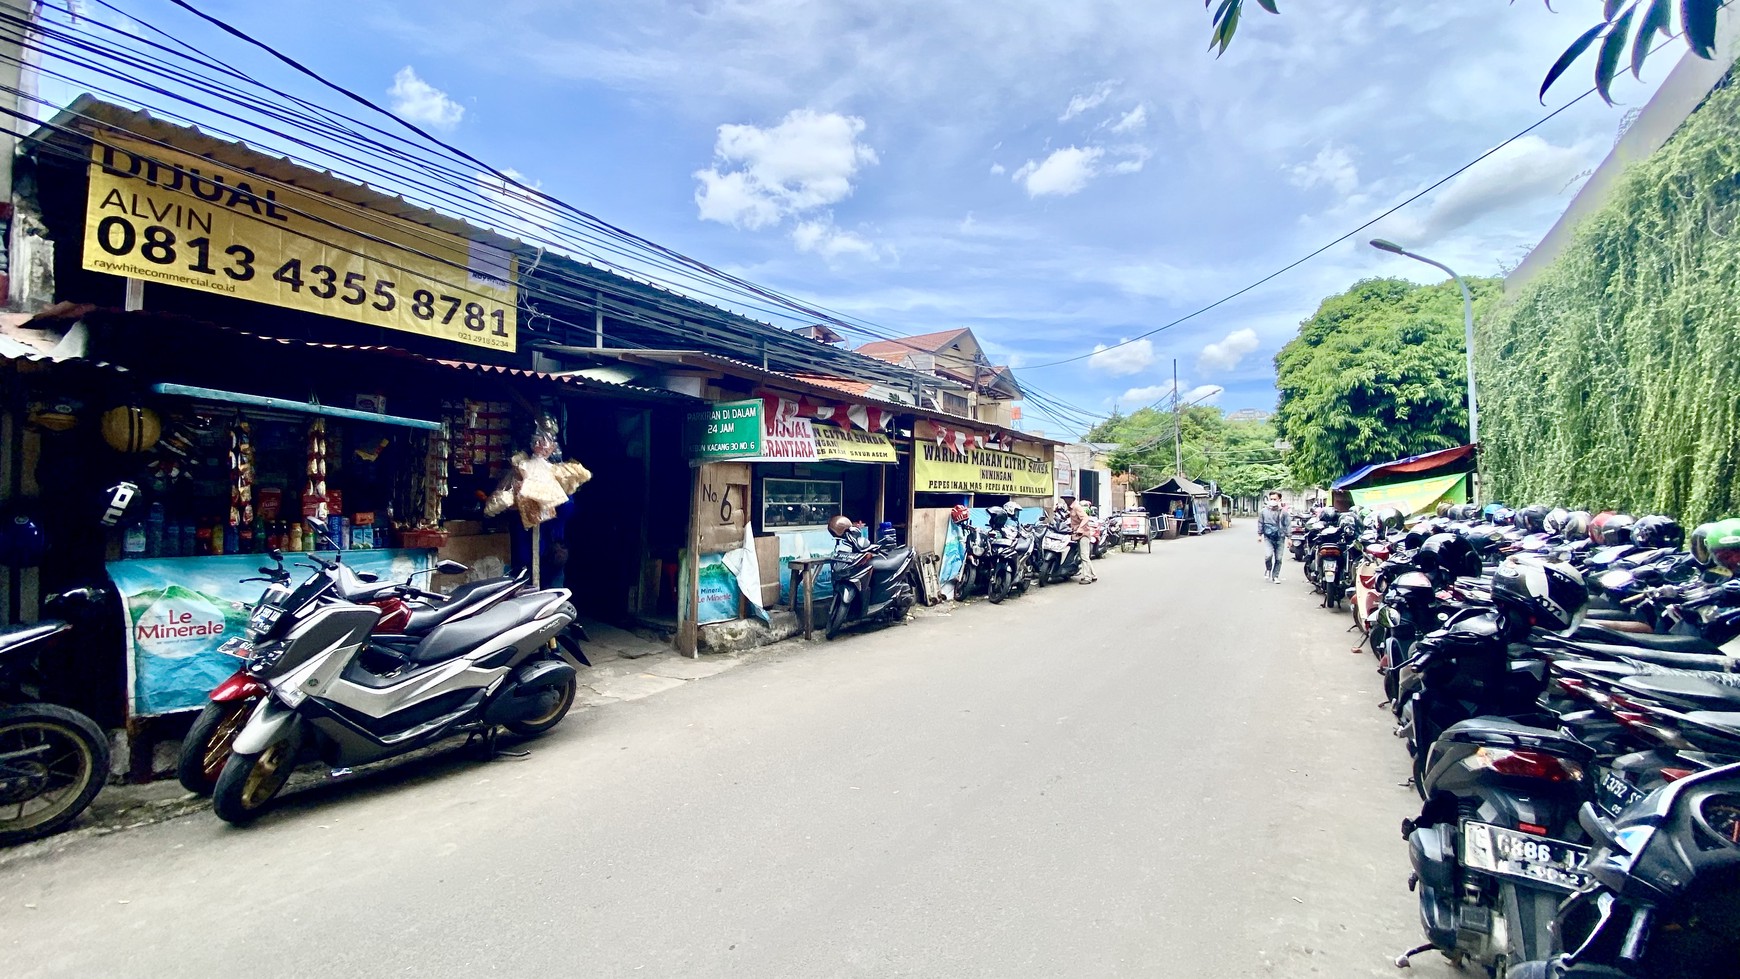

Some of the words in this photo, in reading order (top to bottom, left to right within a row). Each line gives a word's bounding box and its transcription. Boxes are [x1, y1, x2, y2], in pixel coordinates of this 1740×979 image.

[102, 145, 288, 222] DIJUAL
[100, 188, 212, 235] ALVIN
[94, 259, 236, 293] raywhitecommercial.co.id
[97, 215, 256, 281] 0813
[272, 258, 396, 312] 4355
[411, 289, 508, 338] 8781
[458, 331, 472, 341] 021
[491, 339, 509, 348] 5234
[687, 410, 721, 423] PARKIRAN
[722, 409, 731, 420] DI
[732, 406, 757, 419] DALAM
[707, 424, 718, 434] 24
[719, 422, 735, 434] JAM
[766, 418, 811, 438] DIJUAL
[707, 442, 730, 452] KACANG
[730, 442, 739, 451] 30
[750, 441, 755, 450] 6
[923, 444, 969, 465] WARUNG
[971, 449, 1003, 468] MAKAN
[1004, 455, 1026, 471] CITRA
[928, 480, 950, 489] PEPES
[969, 481, 982, 490] MAS
[720, 485, 732, 522] 6
[168, 609, 192, 625] Le
[137, 620, 224, 640] Minerale
[1606, 777, 1628, 798] 3752
